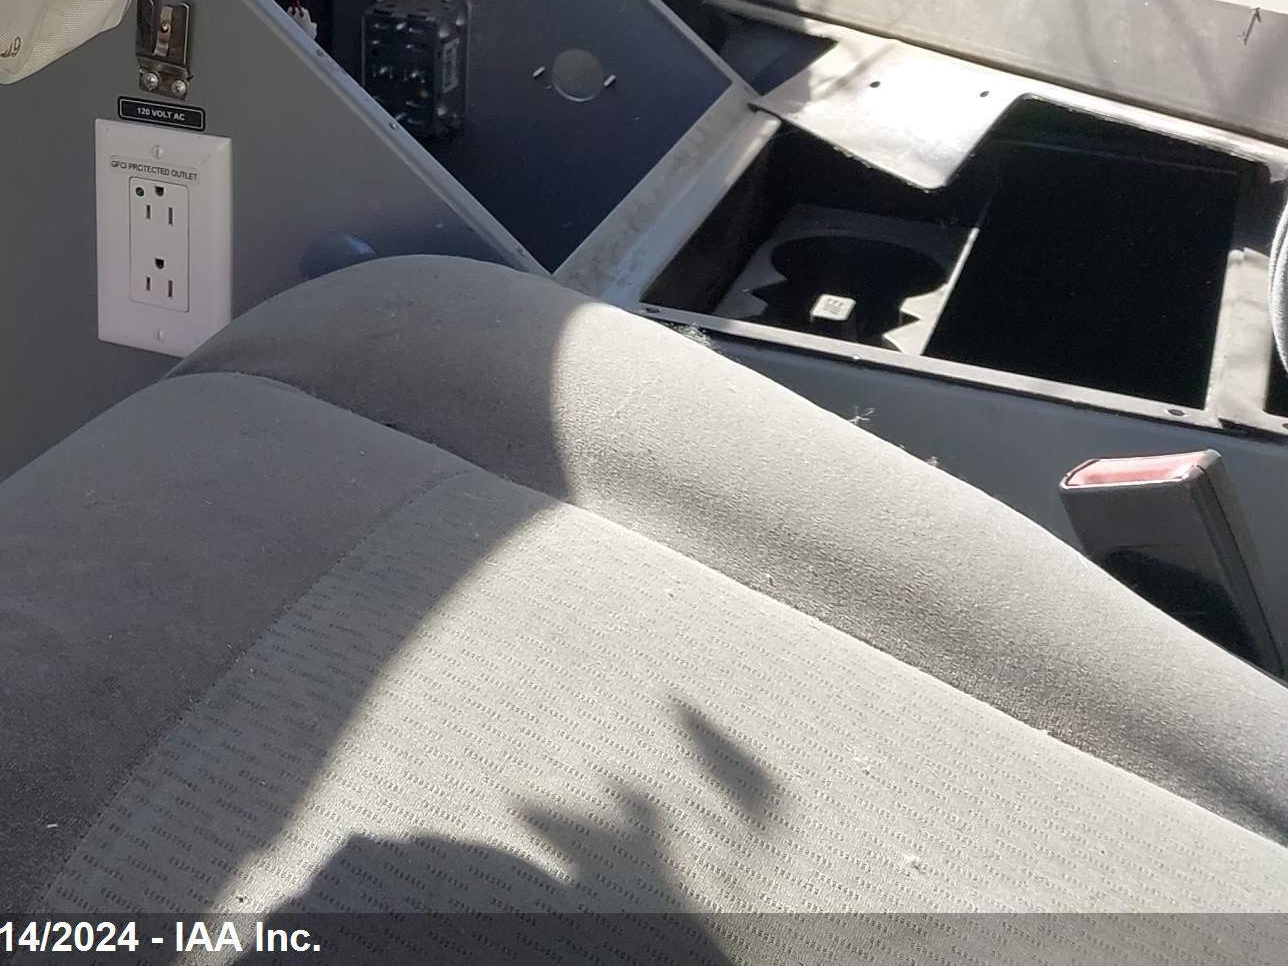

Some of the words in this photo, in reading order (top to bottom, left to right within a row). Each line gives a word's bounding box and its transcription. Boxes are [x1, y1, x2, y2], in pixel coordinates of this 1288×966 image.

[137, 107, 151, 116] 120
[151, 109, 173, 119] VOLT
[173, 113, 186, 121] AC
[110, 160, 127, 169] GFCI
[128, 163, 169, 176] PROTECTED
[171, 169, 198, 180] OUTLET
